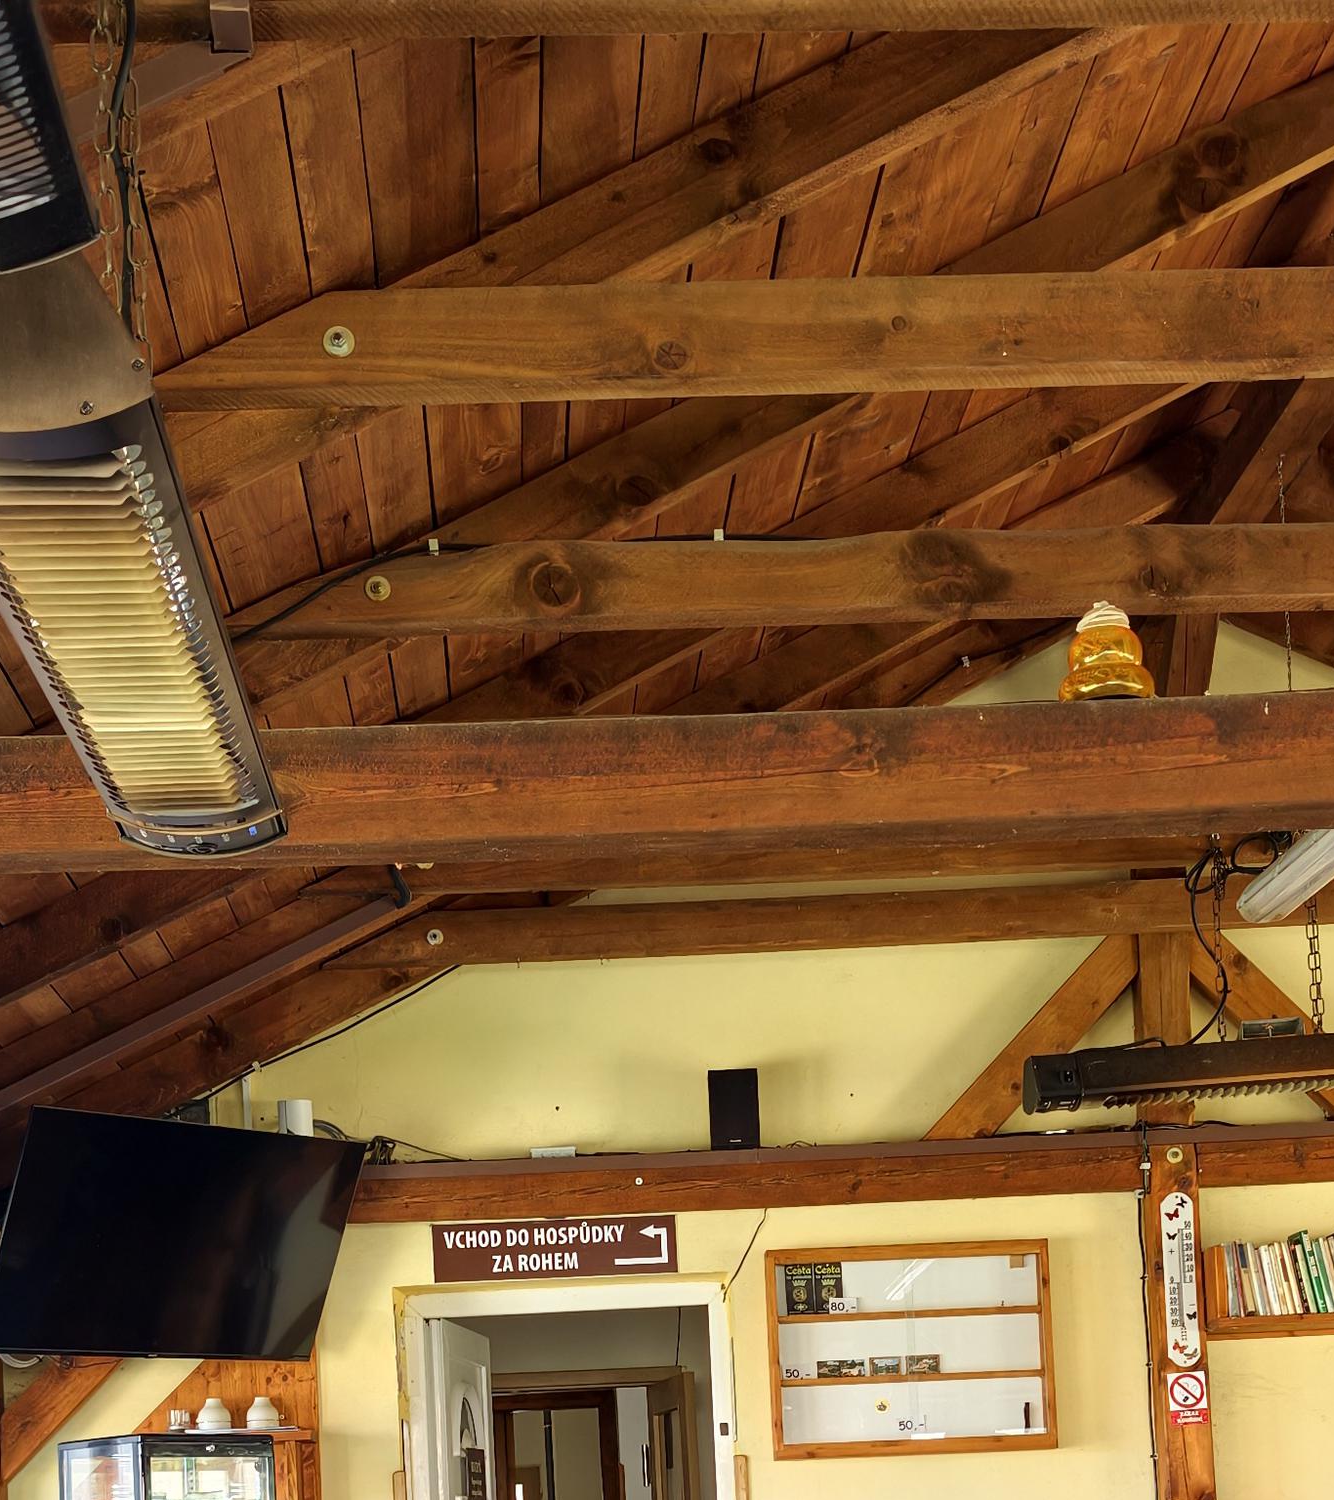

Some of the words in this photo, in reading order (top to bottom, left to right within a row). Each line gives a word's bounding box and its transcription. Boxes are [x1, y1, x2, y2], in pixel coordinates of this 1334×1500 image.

[443, 1229, 502, 1249] VCHOD
[506, 1228, 529, 1248] DO
[533, 1221, 625, 1247] HOSPŮDKY
[491, 1254, 514, 1273] ZA
[517, 1252, 579, 1272] ROHEM
[830, 1302, 857, 1313] 80,-
[785, 1368, 811, 1380] 50,-
